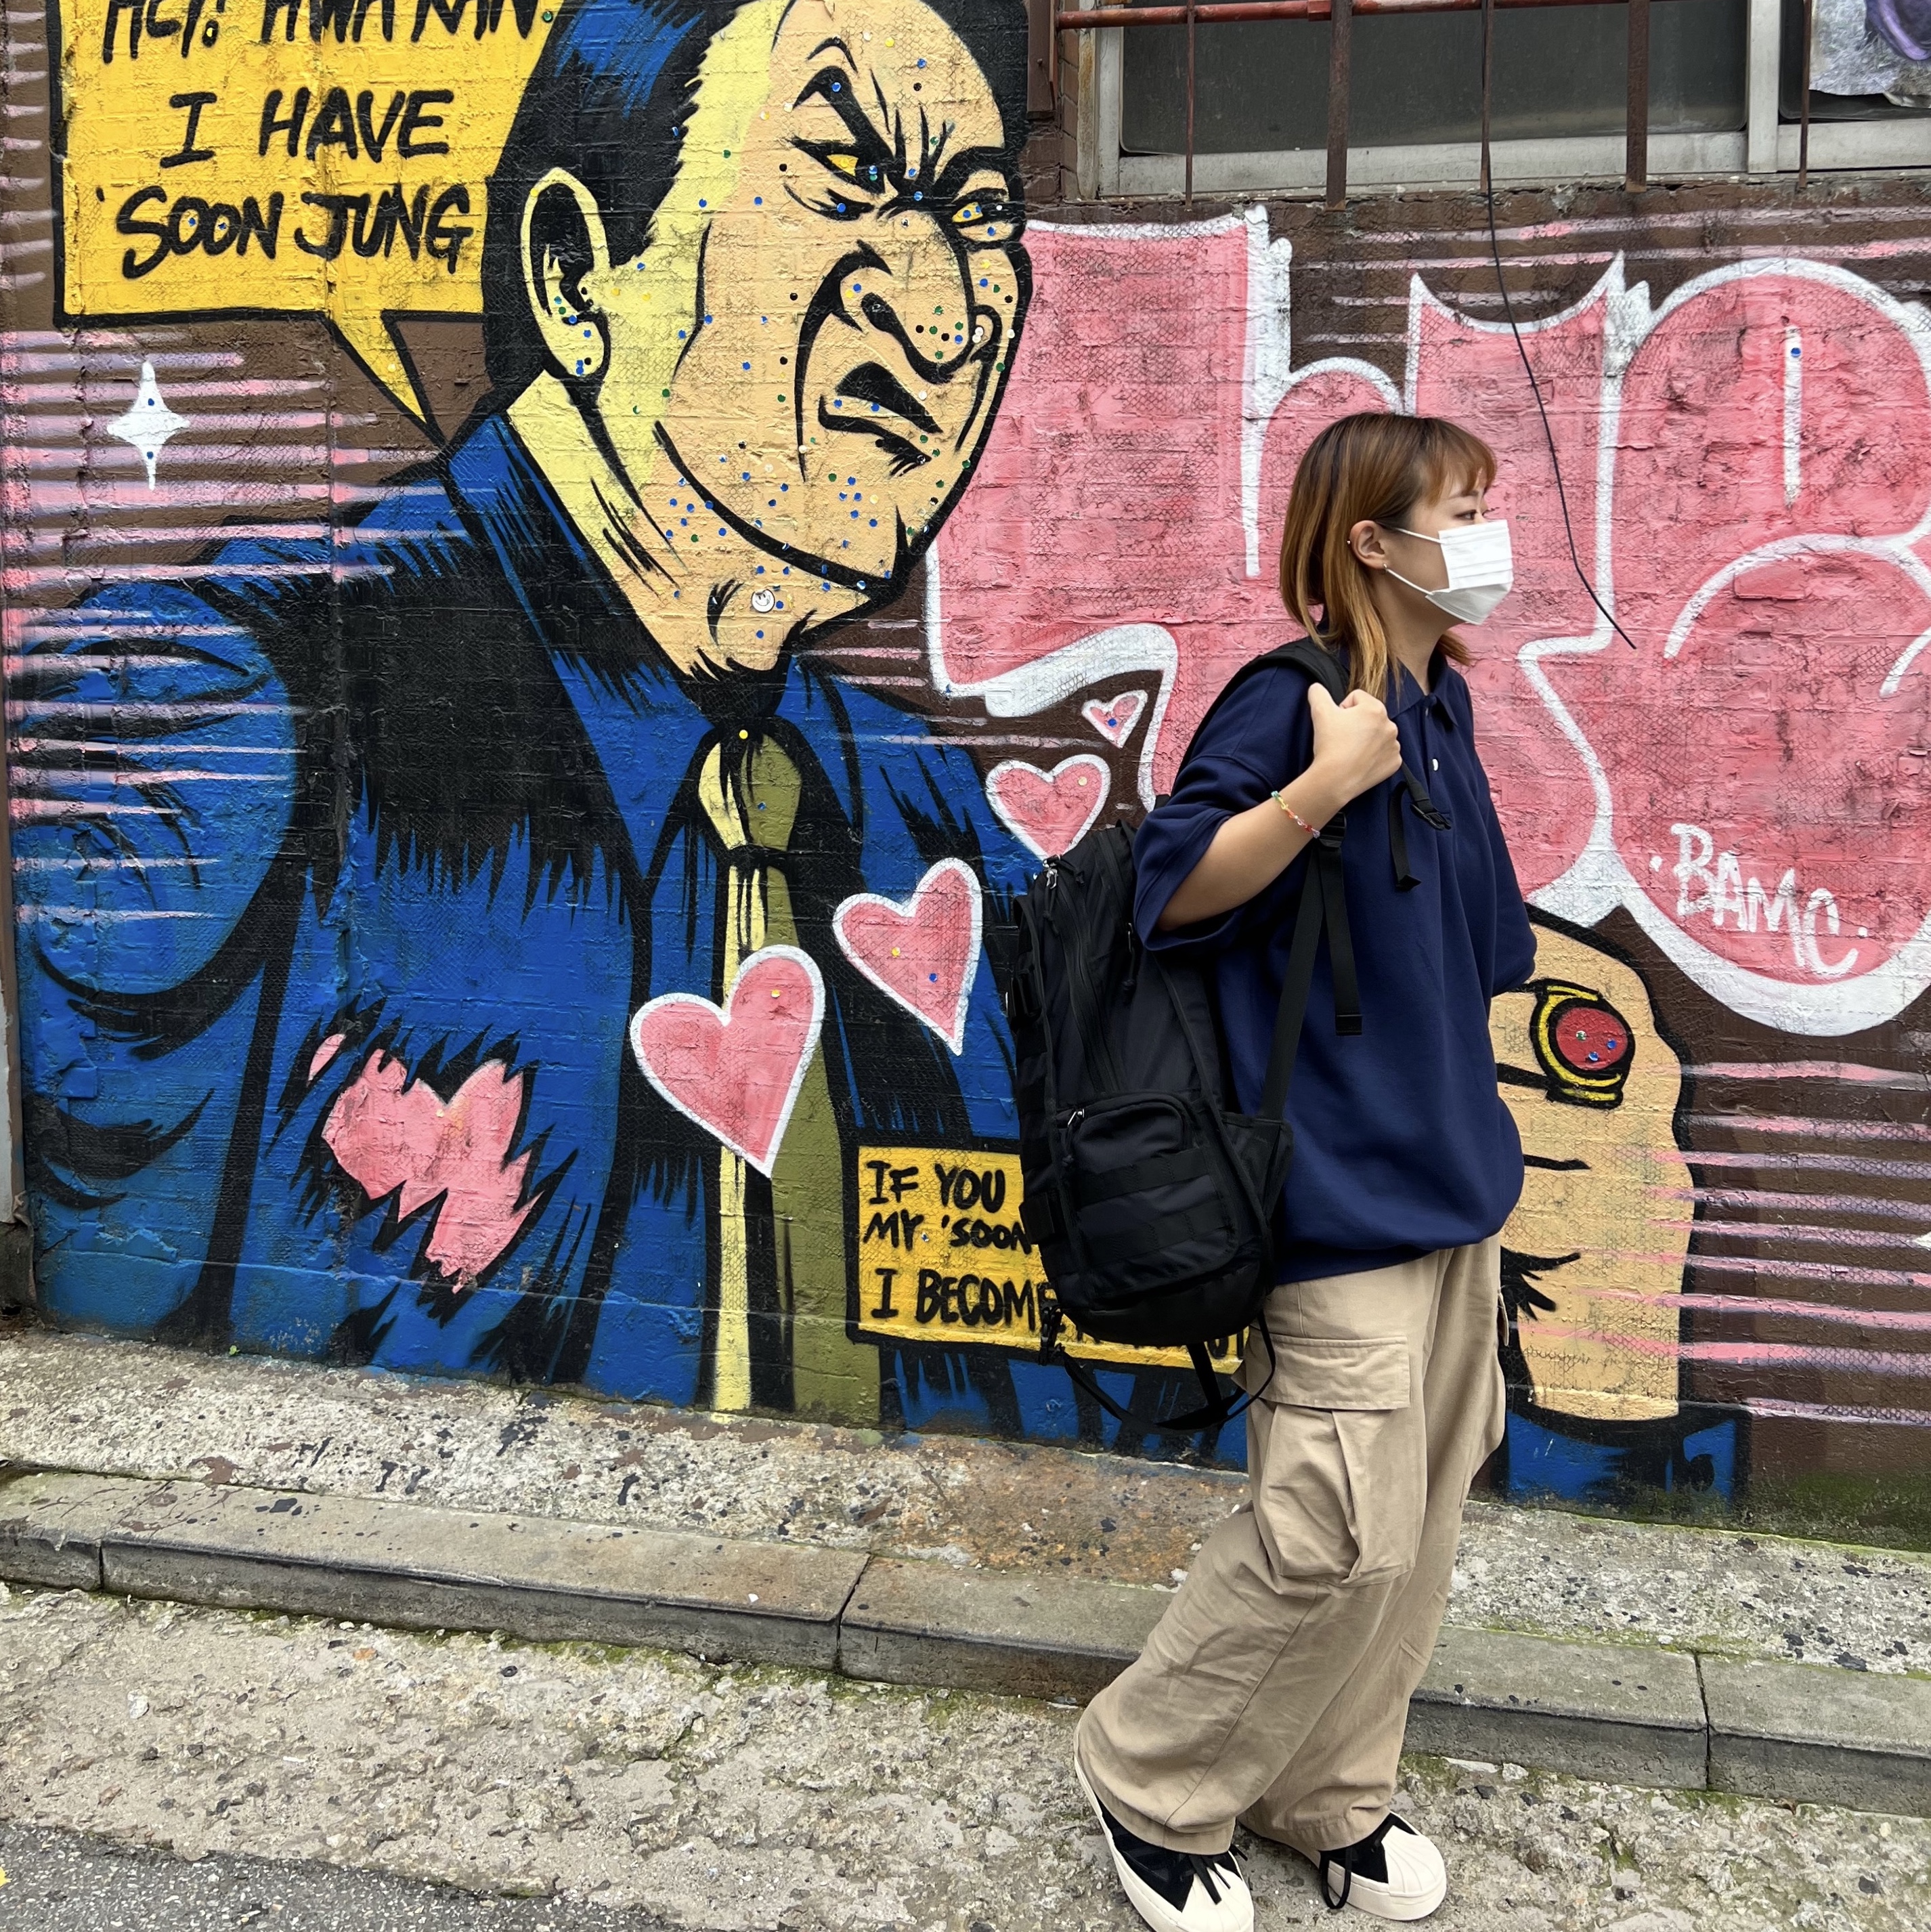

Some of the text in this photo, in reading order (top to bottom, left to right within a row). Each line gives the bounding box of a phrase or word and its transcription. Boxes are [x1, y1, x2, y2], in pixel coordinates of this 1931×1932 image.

[160, 87, 454, 168] I HAVE
[293, 182, 474, 275] JUNG
[865, 1161, 1006, 1214] IF YOU
[862, 1209, 925, 1251] MY
[871, 1268, 899, 1319] I
